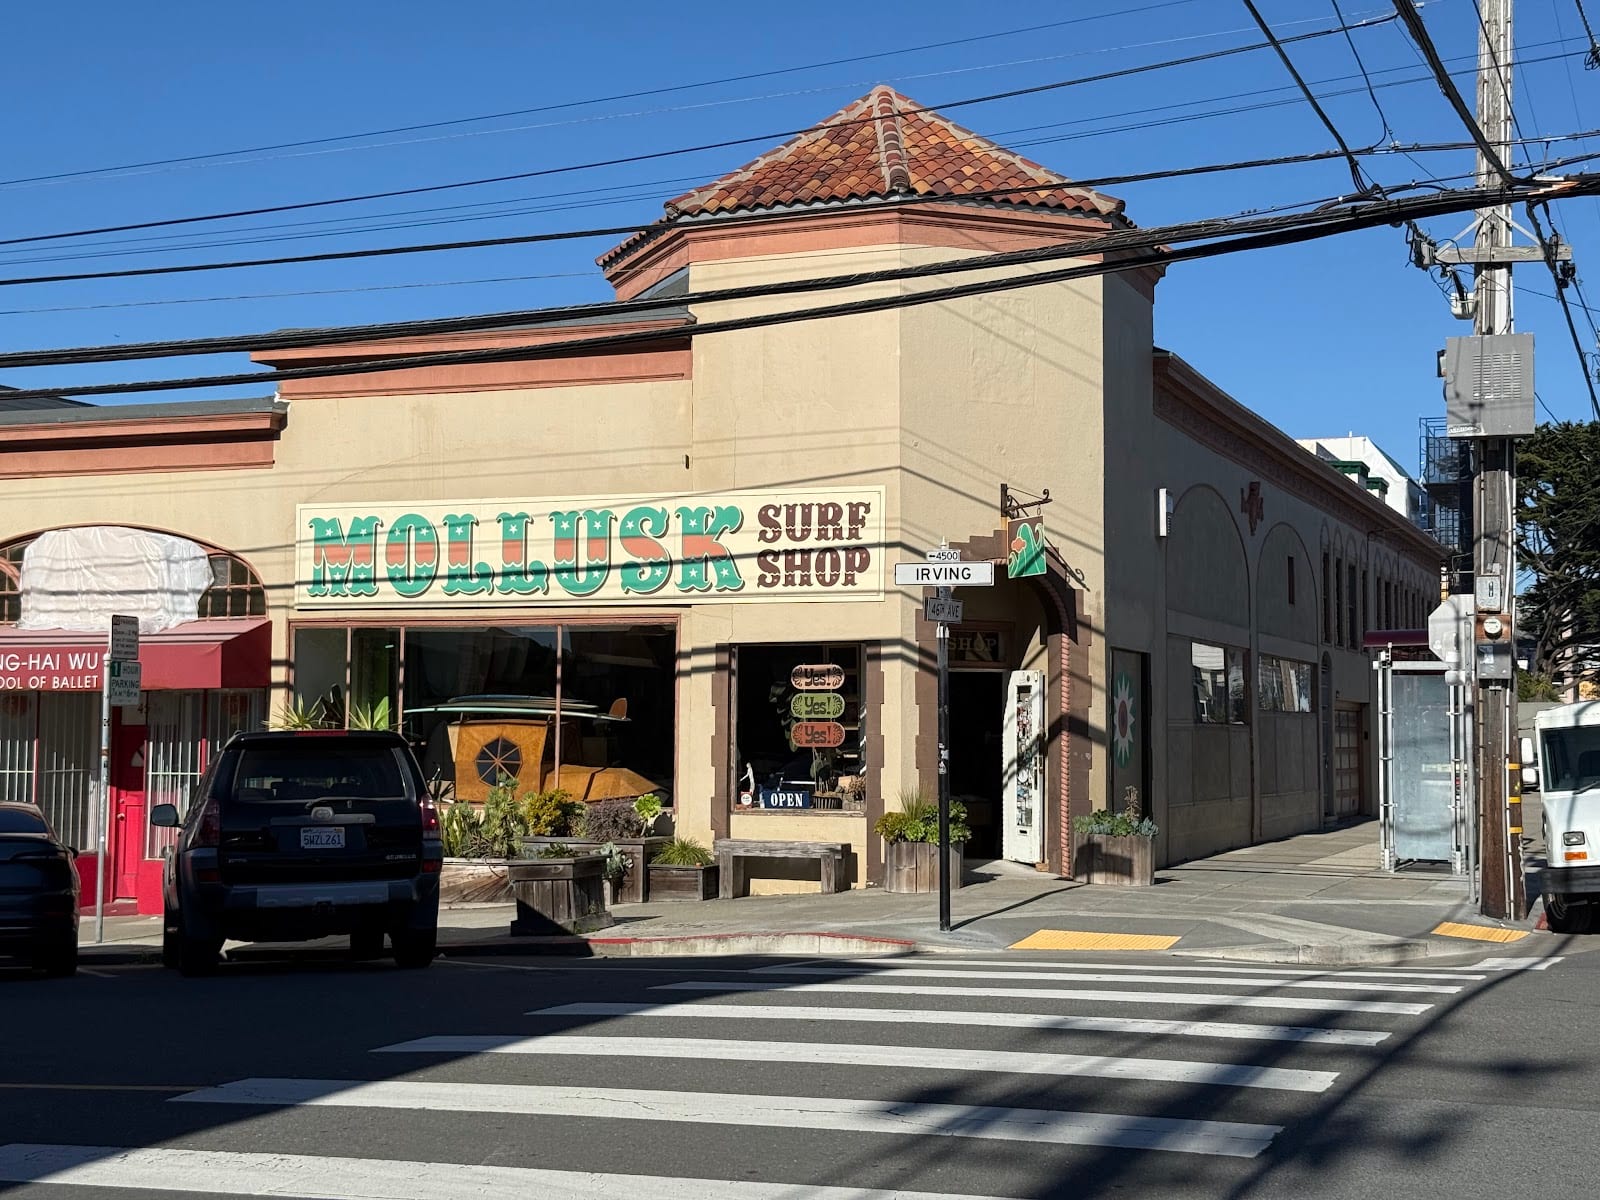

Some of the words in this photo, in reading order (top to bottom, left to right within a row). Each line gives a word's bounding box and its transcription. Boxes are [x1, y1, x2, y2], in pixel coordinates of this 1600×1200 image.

[757, 502, 872, 544] SURF
[308, 507, 745, 597] MOLLUSK
[936, 551, 958, 561] 4500
[757, 546, 872, 589] SHOP
[916, 567, 971, 581] IRVING
[931, 603, 945, 617] 46TH
[947, 605, 960, 618] AVE
[68, 651, 98, 670] WU
[122, 664, 139, 674] HOUR
[29, 675, 47, 689] OF
[52, 674, 98, 689] BALLET
[112, 679, 140, 689] PARKING
[804, 668, 831, 687] Yes!
[804, 696, 831, 715] Yes!
[804, 725, 831, 744] Yes!
[770, 792, 804, 807] OPEN
